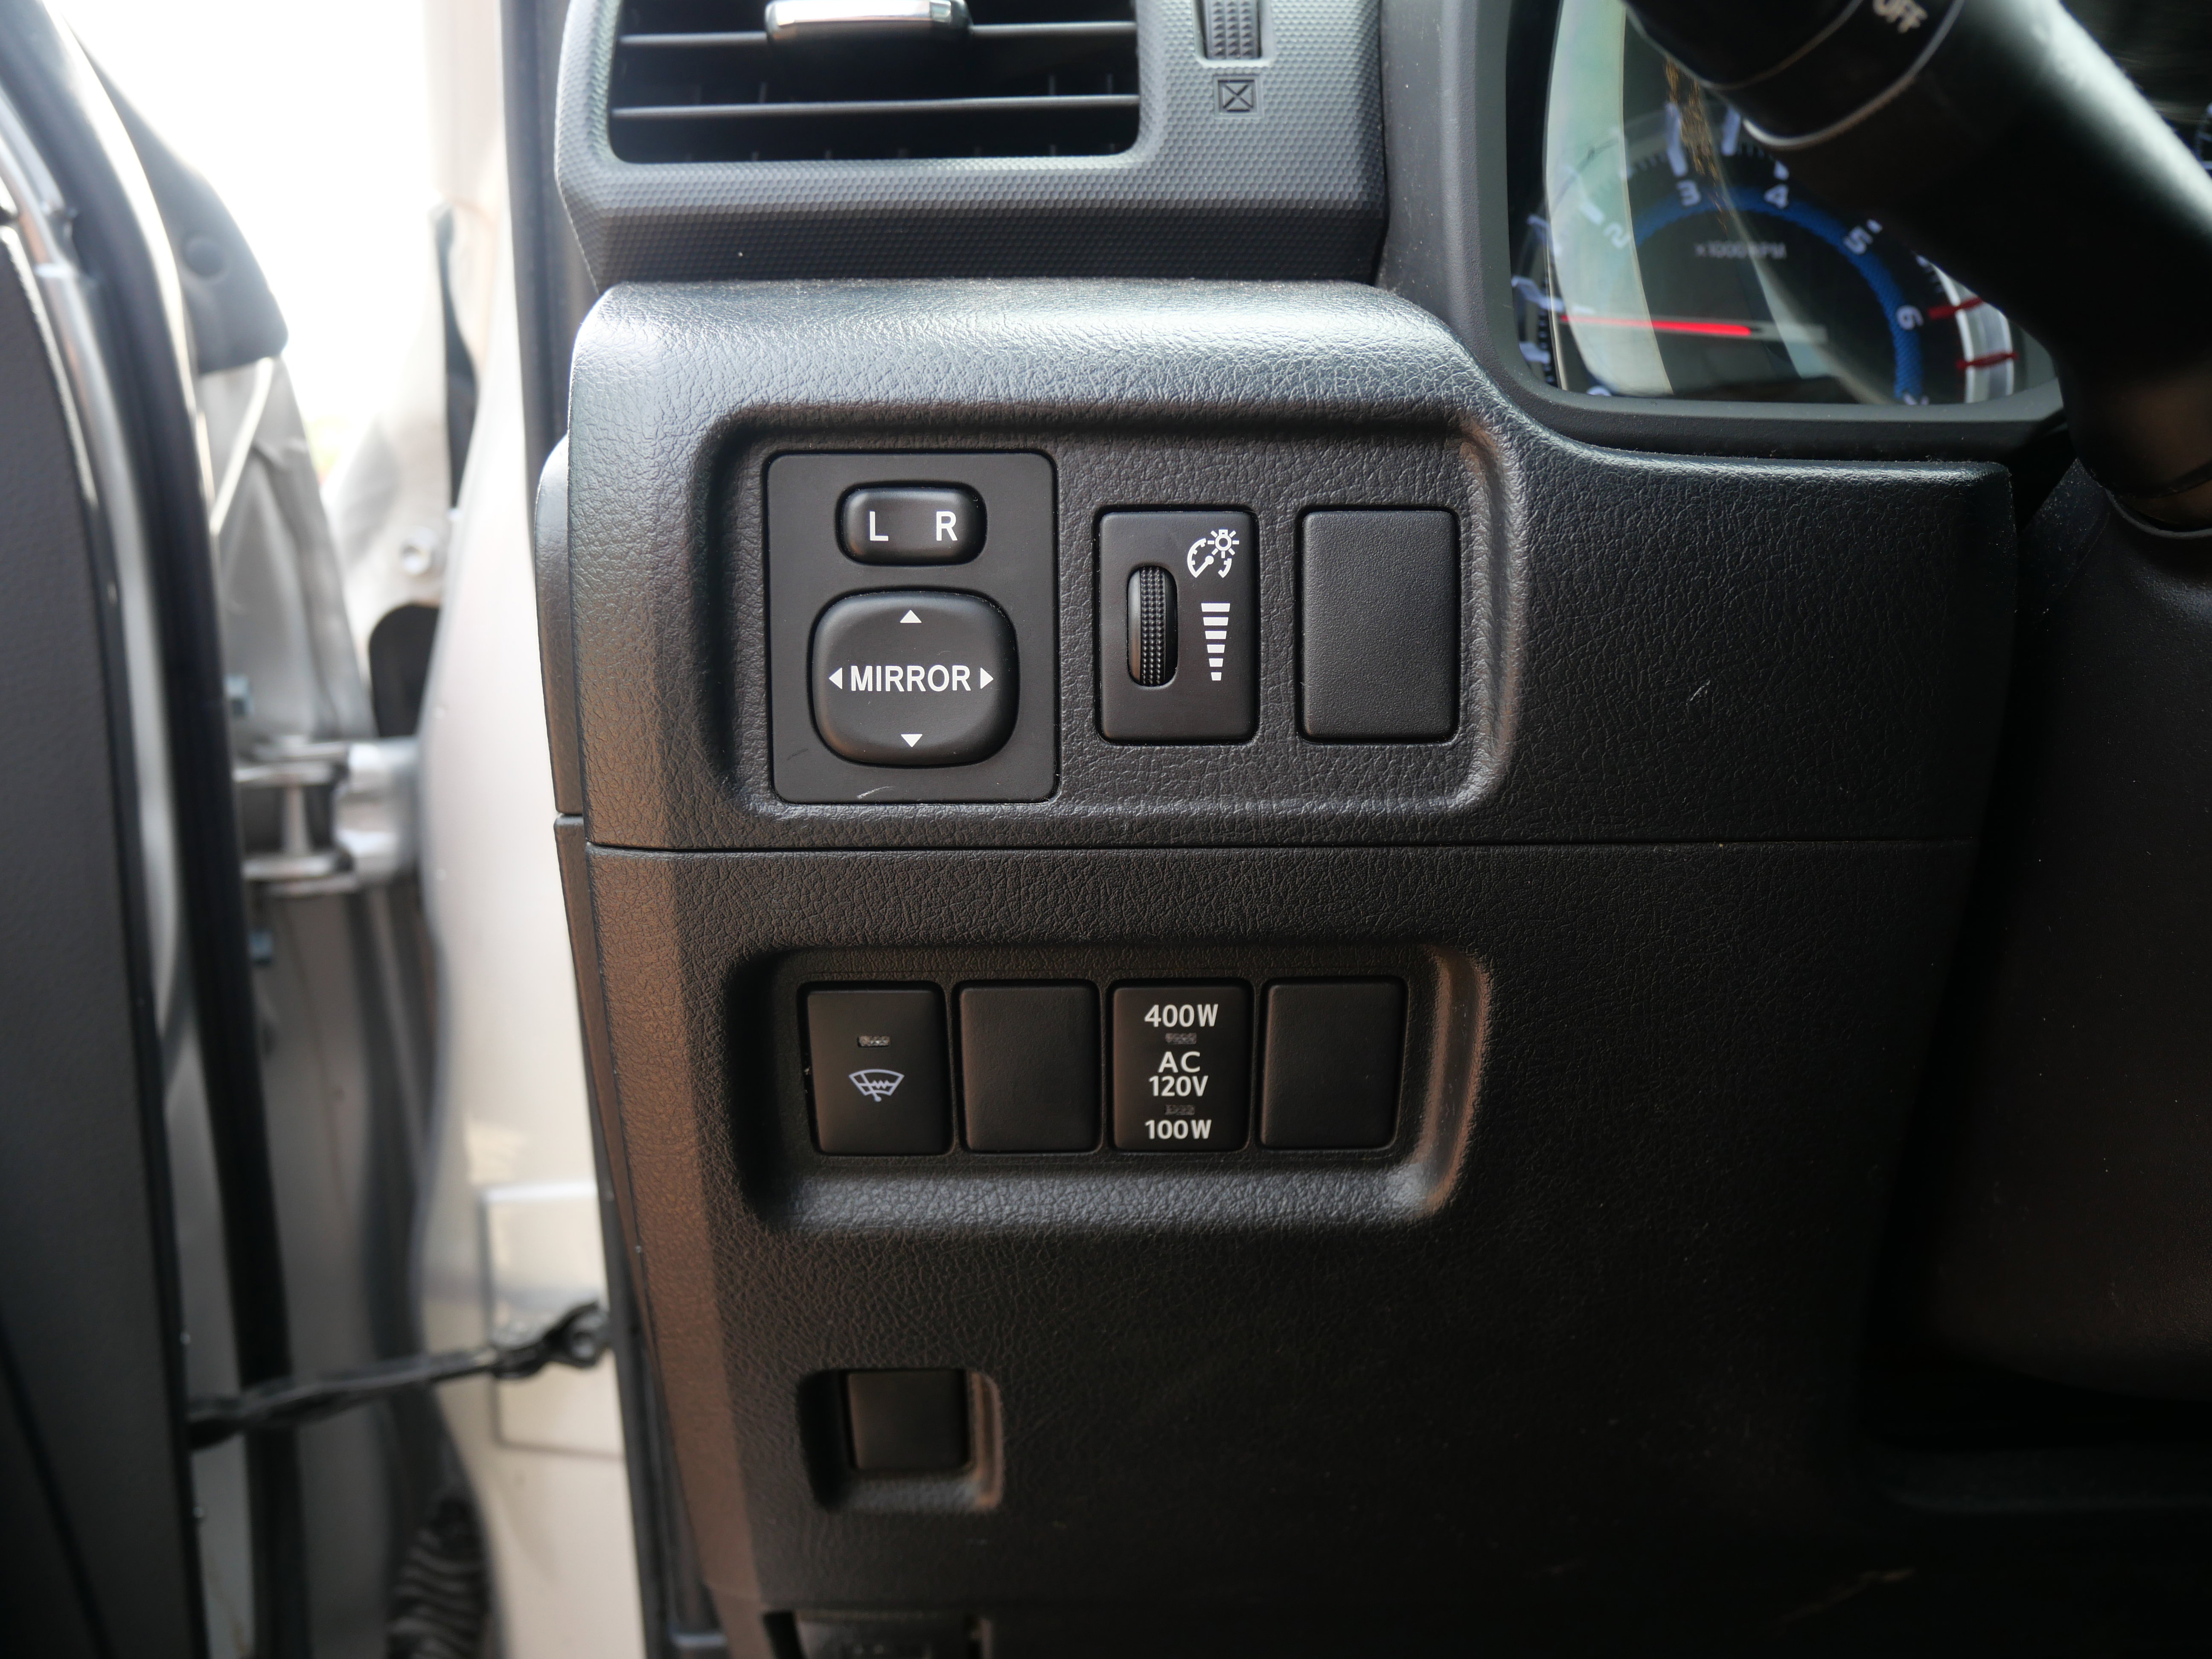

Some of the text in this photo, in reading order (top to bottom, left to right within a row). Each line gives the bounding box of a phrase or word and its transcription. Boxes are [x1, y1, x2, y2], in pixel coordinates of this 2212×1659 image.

[1676, 179, 1702, 207] 3
[1763, 183, 1790, 209] 4
[1603, 221, 1631, 249] 2
[1843, 225, 1873, 255] 5
[1896, 305, 1924, 331] 6
[869, 510, 958, 541] L R
[850, 665, 972, 692] MIRROR
[1144, 1004, 1219, 1027] 400W
[1158, 1051, 1201, 1073] AC
[1148, 1075, 1209, 1097] 120V
[1145, 1119, 1212, 1140] 100W
